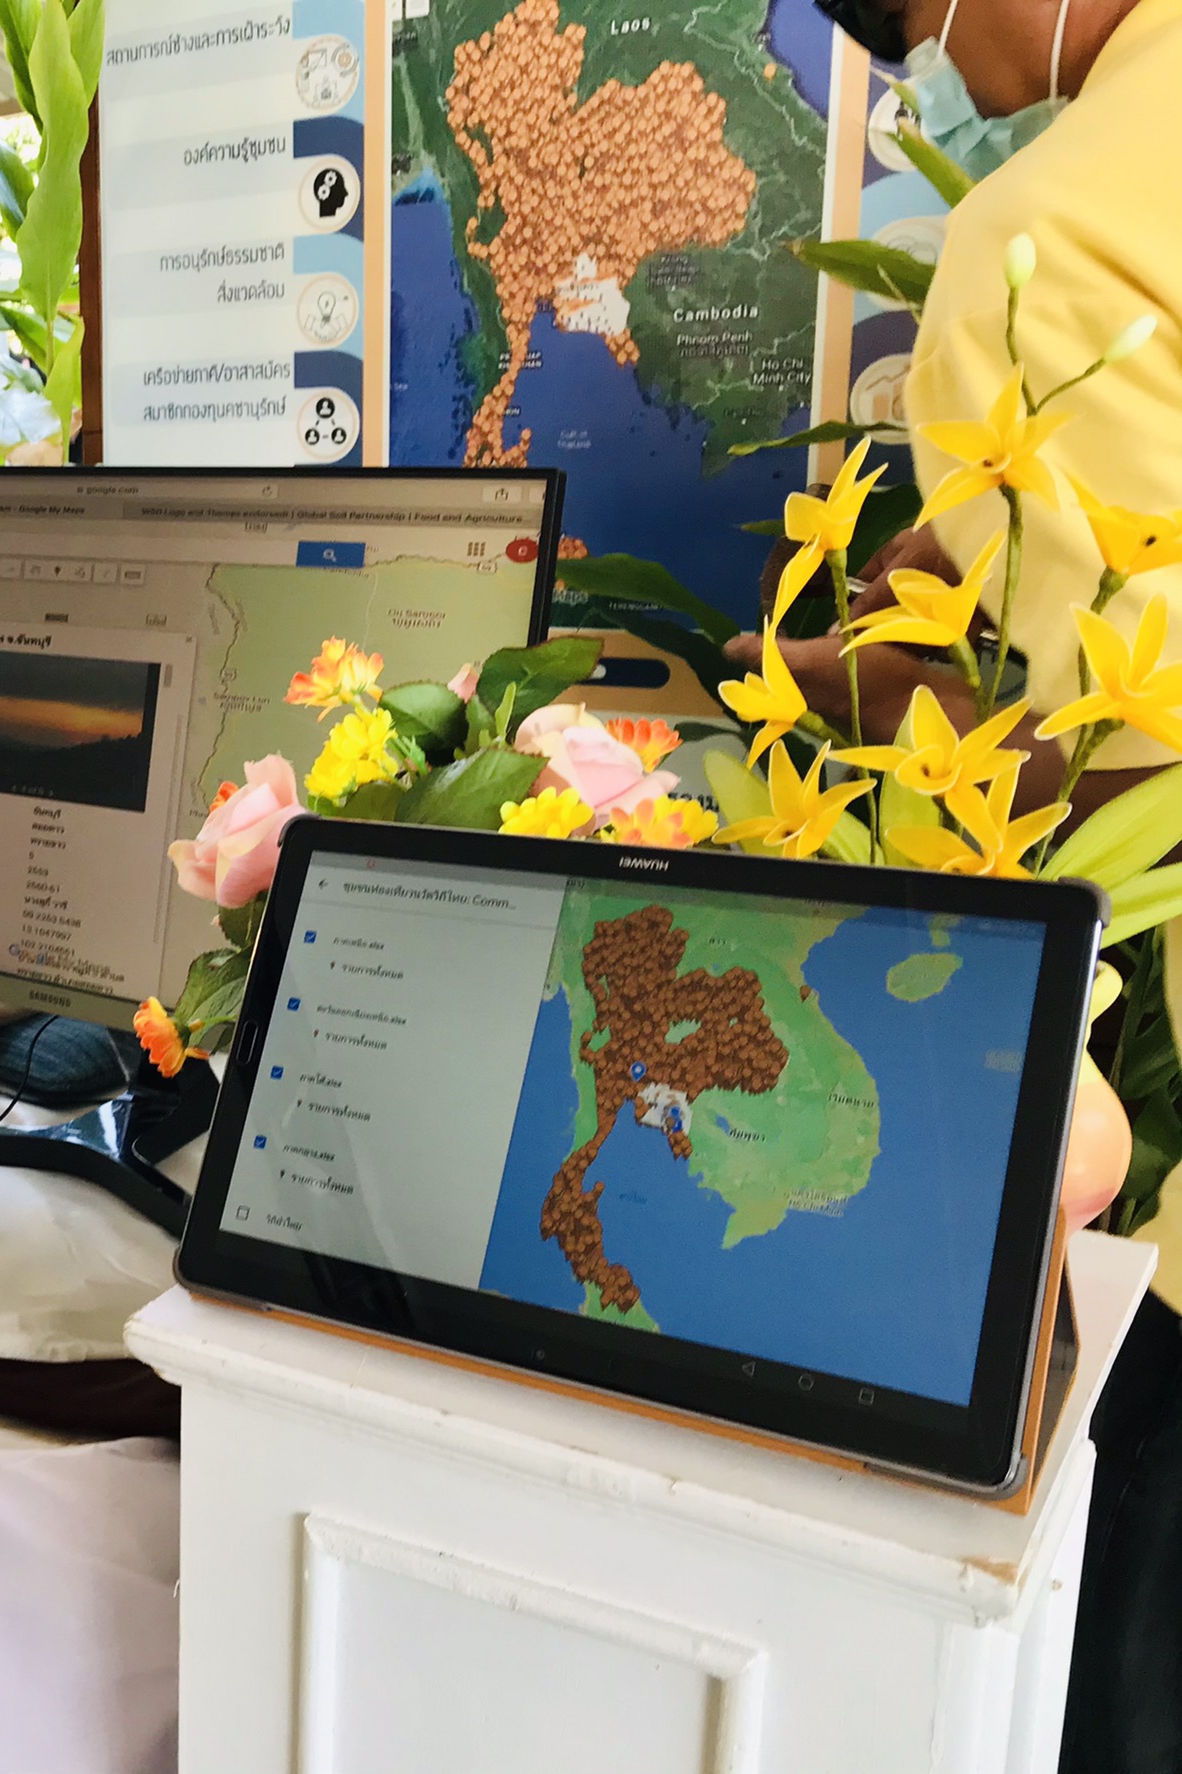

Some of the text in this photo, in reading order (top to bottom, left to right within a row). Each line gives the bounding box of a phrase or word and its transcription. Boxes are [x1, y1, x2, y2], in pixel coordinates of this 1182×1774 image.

[610, 17, 650, 36] Laos
[184, 136, 286, 165] องค์ความรู้ชุมชน
[160, 243, 285, 273] การอนุรักษ์ธรรมชาติ
[217, 280, 285, 304] สิ่งแวดล้อม
[673, 304, 759, 323] Cambodia
[676, 330, 752, 347] Phnom Penh
[143, 360, 290, 387] เครือข่ายภาคี/อาสาสมัคร
[761, 357, 804, 371] Ho Chi
[753, 371, 812, 385] Minh City
[143, 396, 286, 424] สมาชิกกองทุนคชานุรักษ์
[349, 511, 406, 522] Partnership
[414, 512, 440, 521] Food
[443, 513, 462, 522] and
[464, 514, 523, 524] Agriculture
[619, 857, 669, 872] HUAWEI
[29, 990, 71, 1008] SAMSUNG
